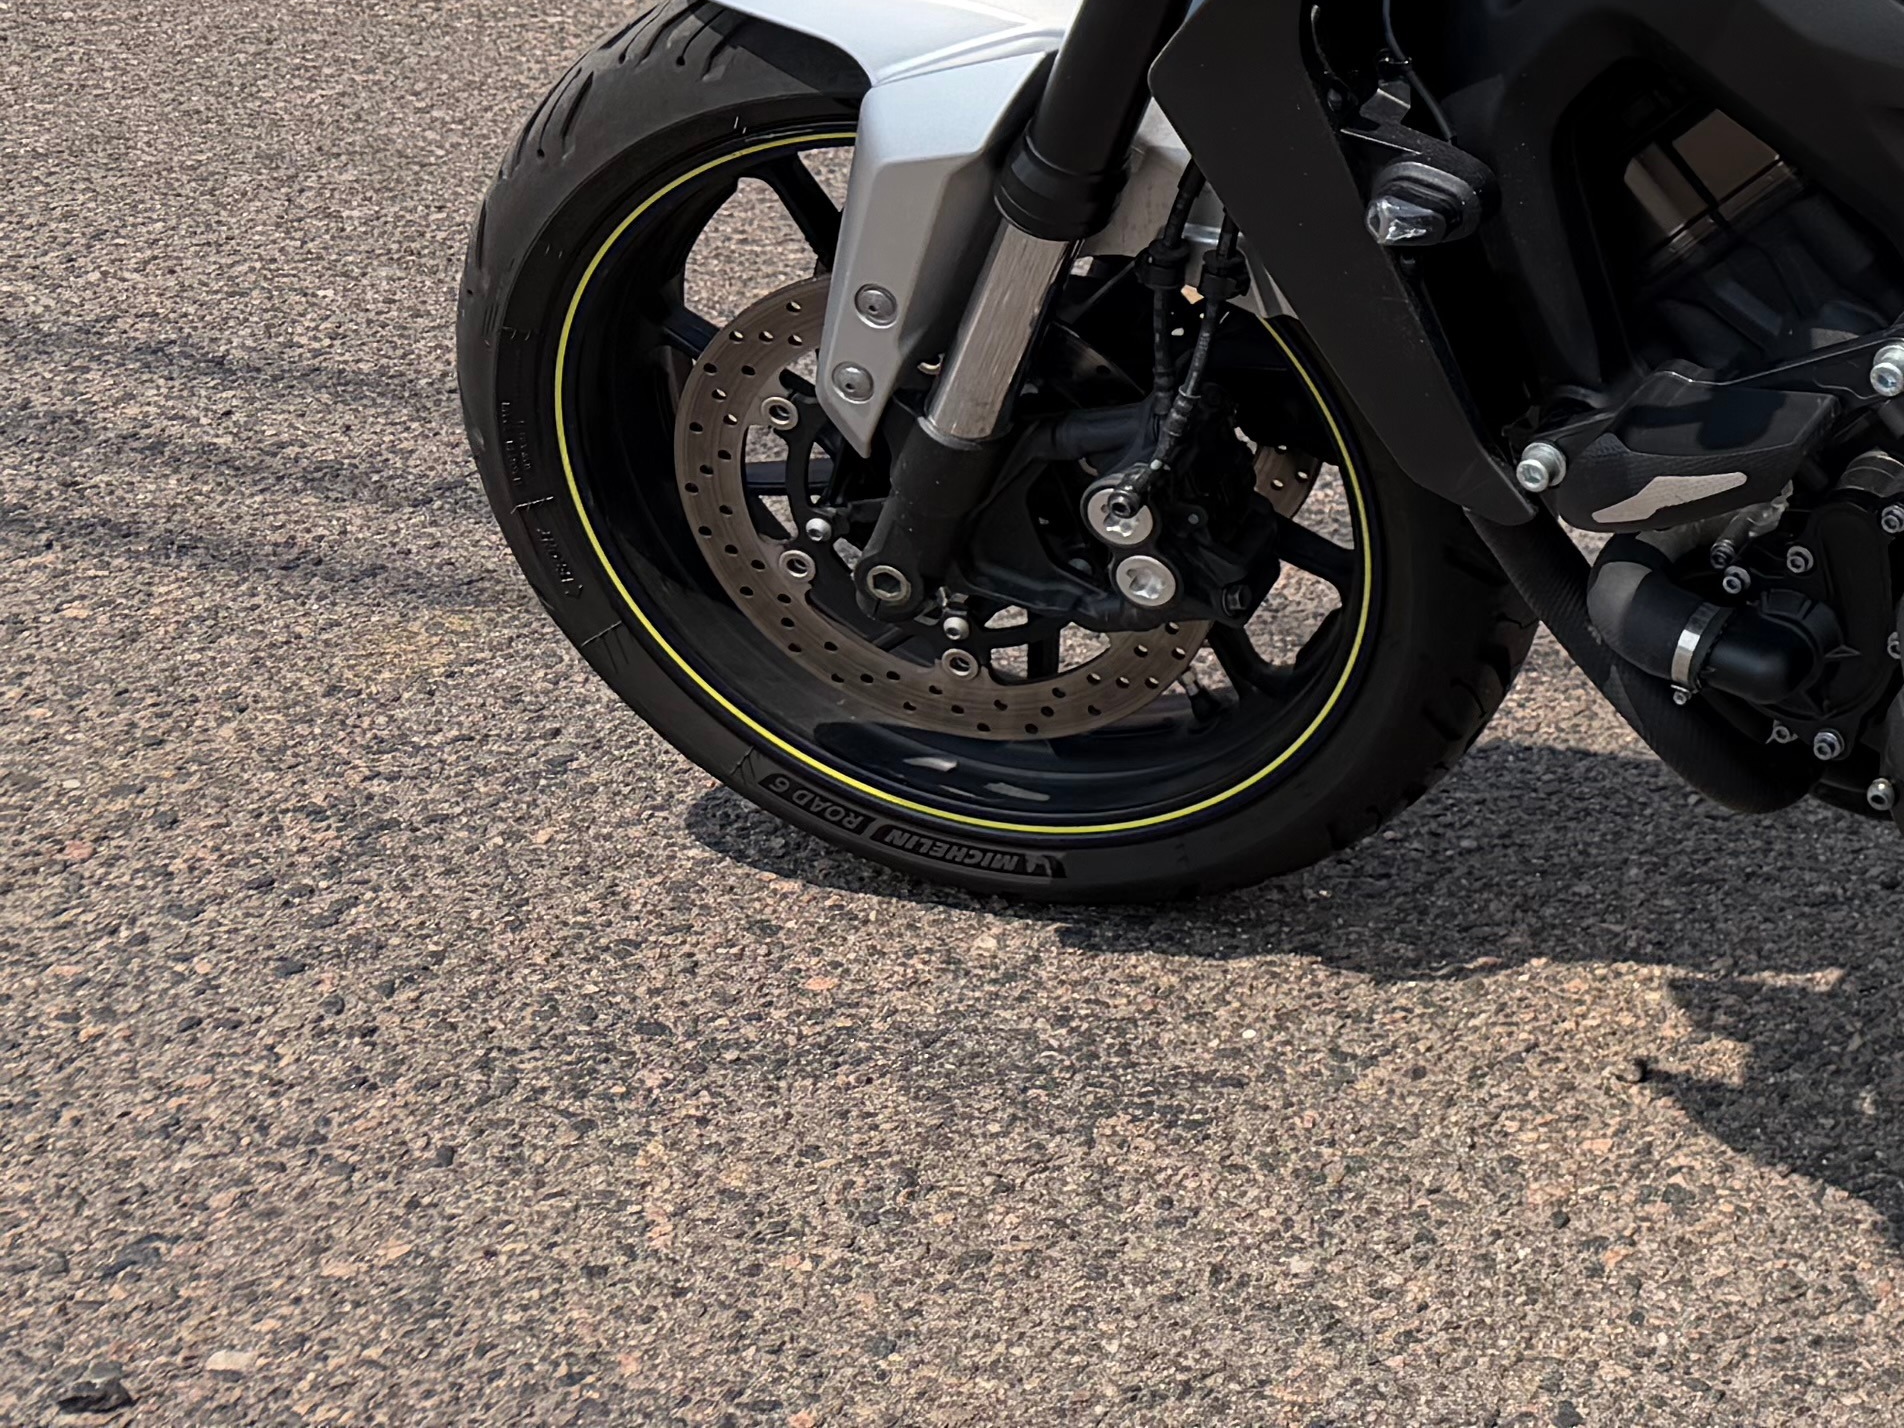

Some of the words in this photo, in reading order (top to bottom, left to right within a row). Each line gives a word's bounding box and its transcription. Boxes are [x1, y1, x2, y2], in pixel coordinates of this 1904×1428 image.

[768, 774, 790, 792] 6
[793, 790, 864, 828] ROAD
[884, 829, 1019, 871] MICHELIN
